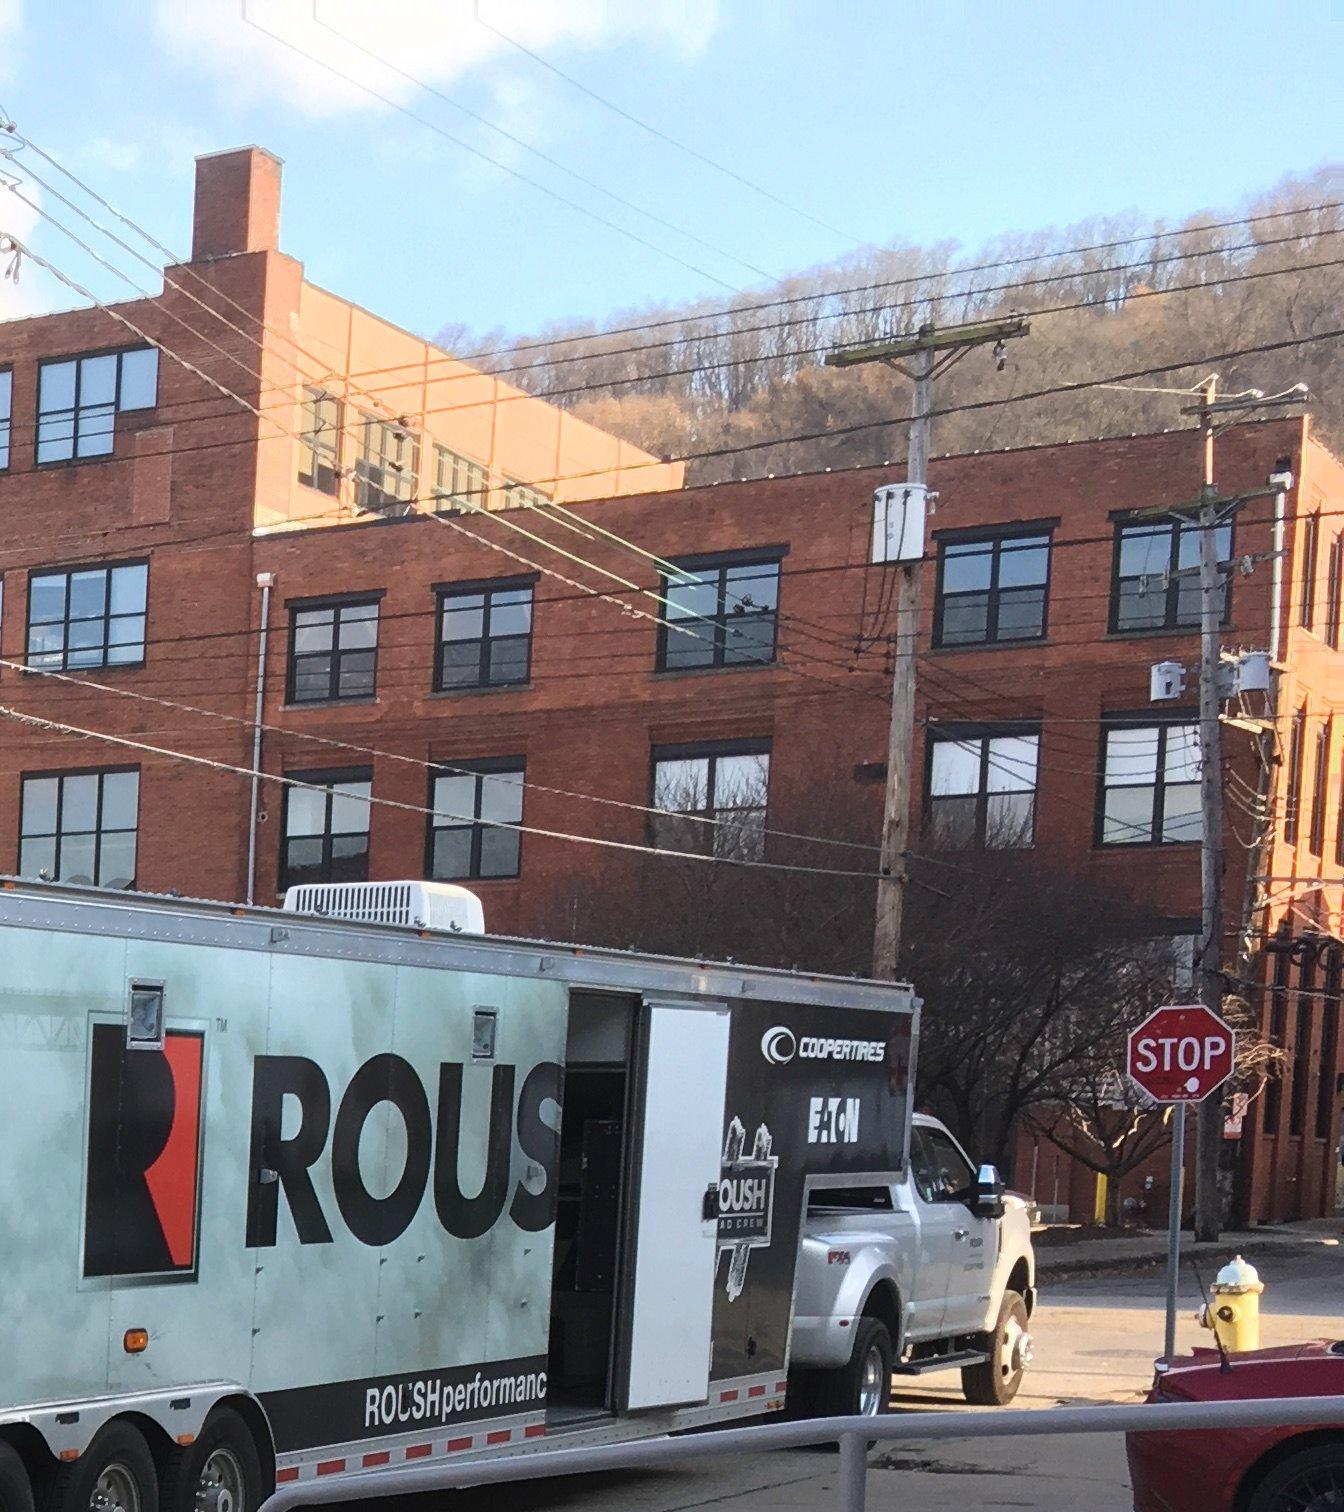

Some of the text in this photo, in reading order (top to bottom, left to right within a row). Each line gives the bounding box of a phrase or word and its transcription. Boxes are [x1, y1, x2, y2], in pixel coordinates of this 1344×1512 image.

[1136, 1035, 1226, 1073] STOP
[808, 1097, 860, 1144] EATON
[736, 1218, 765, 1229] CREW
